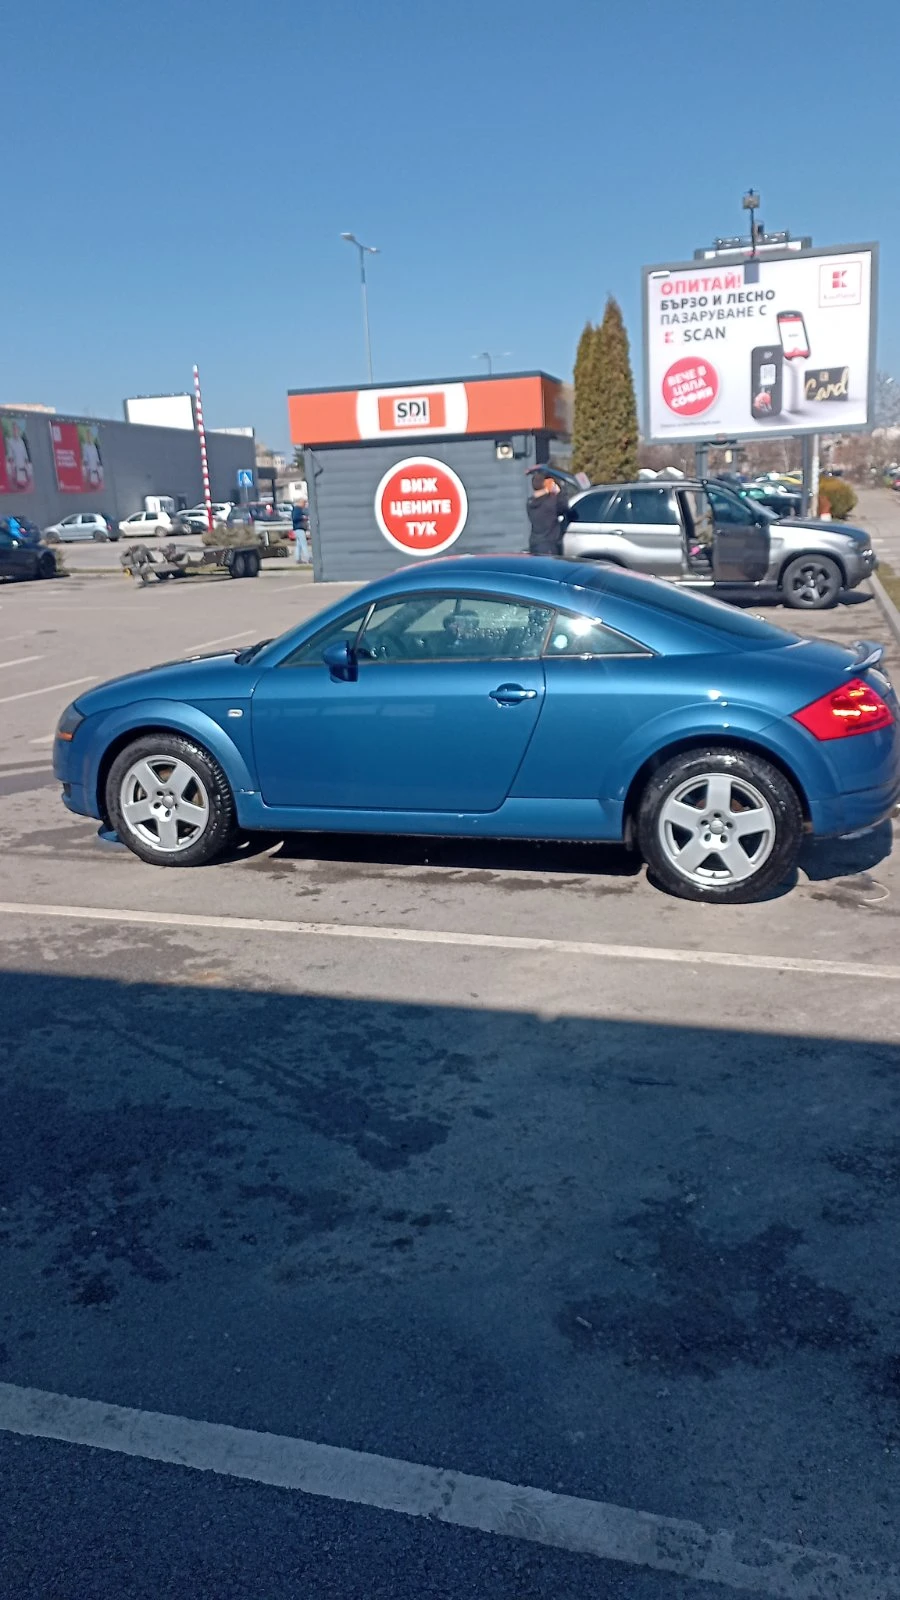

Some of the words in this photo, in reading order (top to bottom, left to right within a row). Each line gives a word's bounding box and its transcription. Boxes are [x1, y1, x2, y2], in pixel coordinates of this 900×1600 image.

[661, 272, 742, 296] ОПИТАЙ!
[660, 296, 708, 311] БЪРЗО
[713, 294, 722, 306] И
[726, 289, 776, 304] ЛЕСНО
[660, 305, 754, 326] ПАЗАРУВАНЕ
[683, 326, 726, 342] SCAN
[397, 401, 427, 418] SDI
[400, 477, 438, 493] ВИЖ
[390, 499, 452, 517] ЦЕНИТЕ
[406, 521, 437, 536] ТУК
